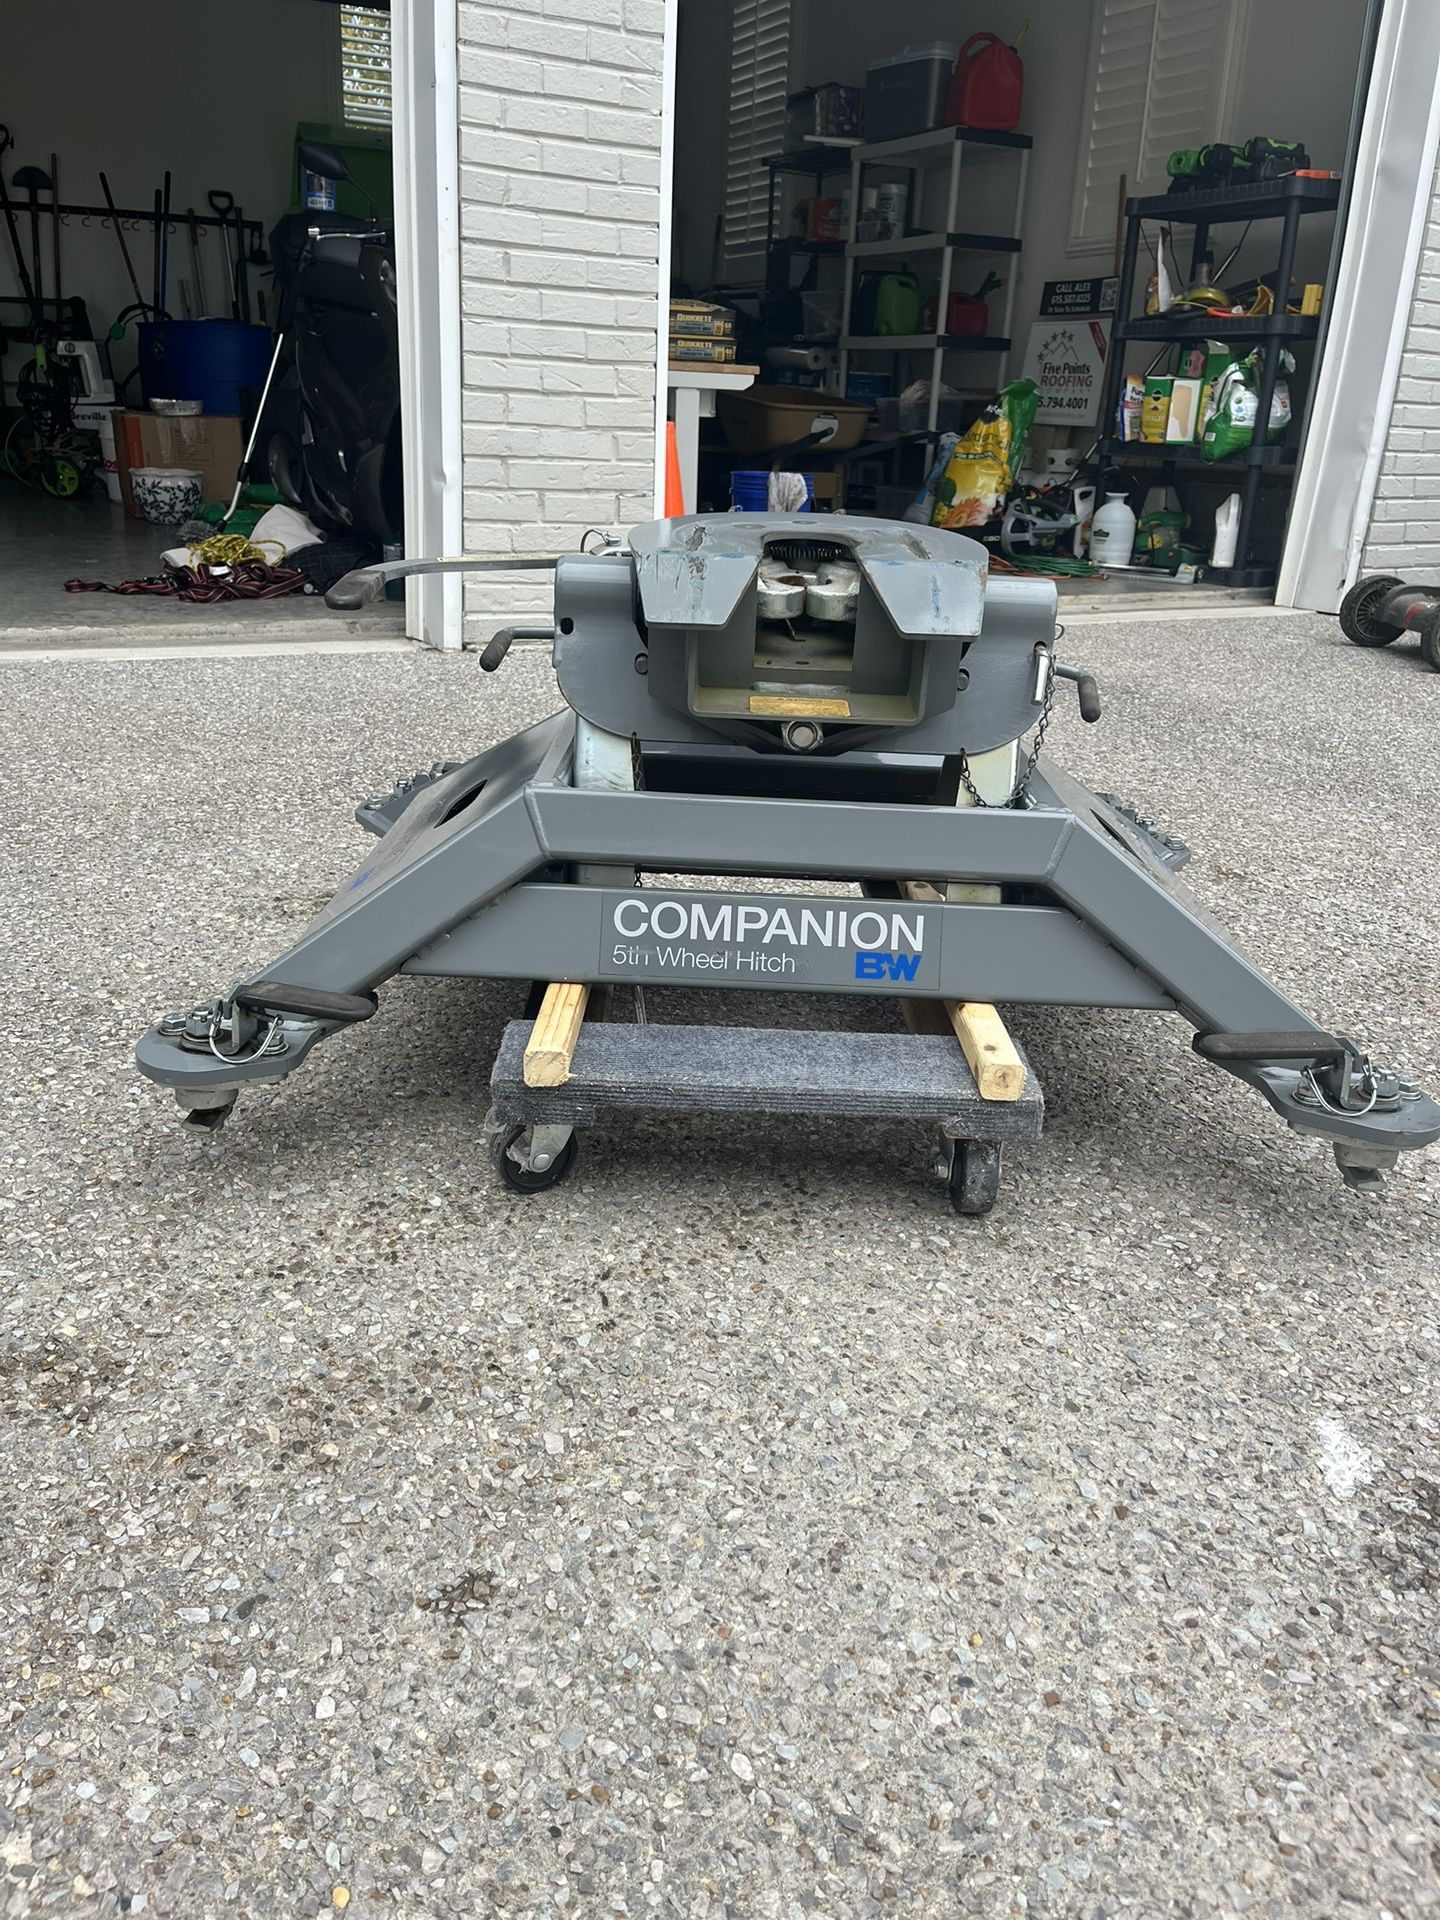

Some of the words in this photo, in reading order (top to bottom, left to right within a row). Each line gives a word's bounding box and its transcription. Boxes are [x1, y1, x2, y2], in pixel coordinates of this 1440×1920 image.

[1056, 283, 1072, 293] CALL
[1073, 282, 1091, 292] ALEX
[1043, 361, 1061, 374] Five
[1063, 361, 1091, 375] Points
[1040, 375, 1092, 388] ROOFING
[613, 899, 925, 952] COMPANION
[612, 945, 649, 966] 5th
[656, 946, 729, 970] Wheel
[737, 951, 796, 974] Hitch
